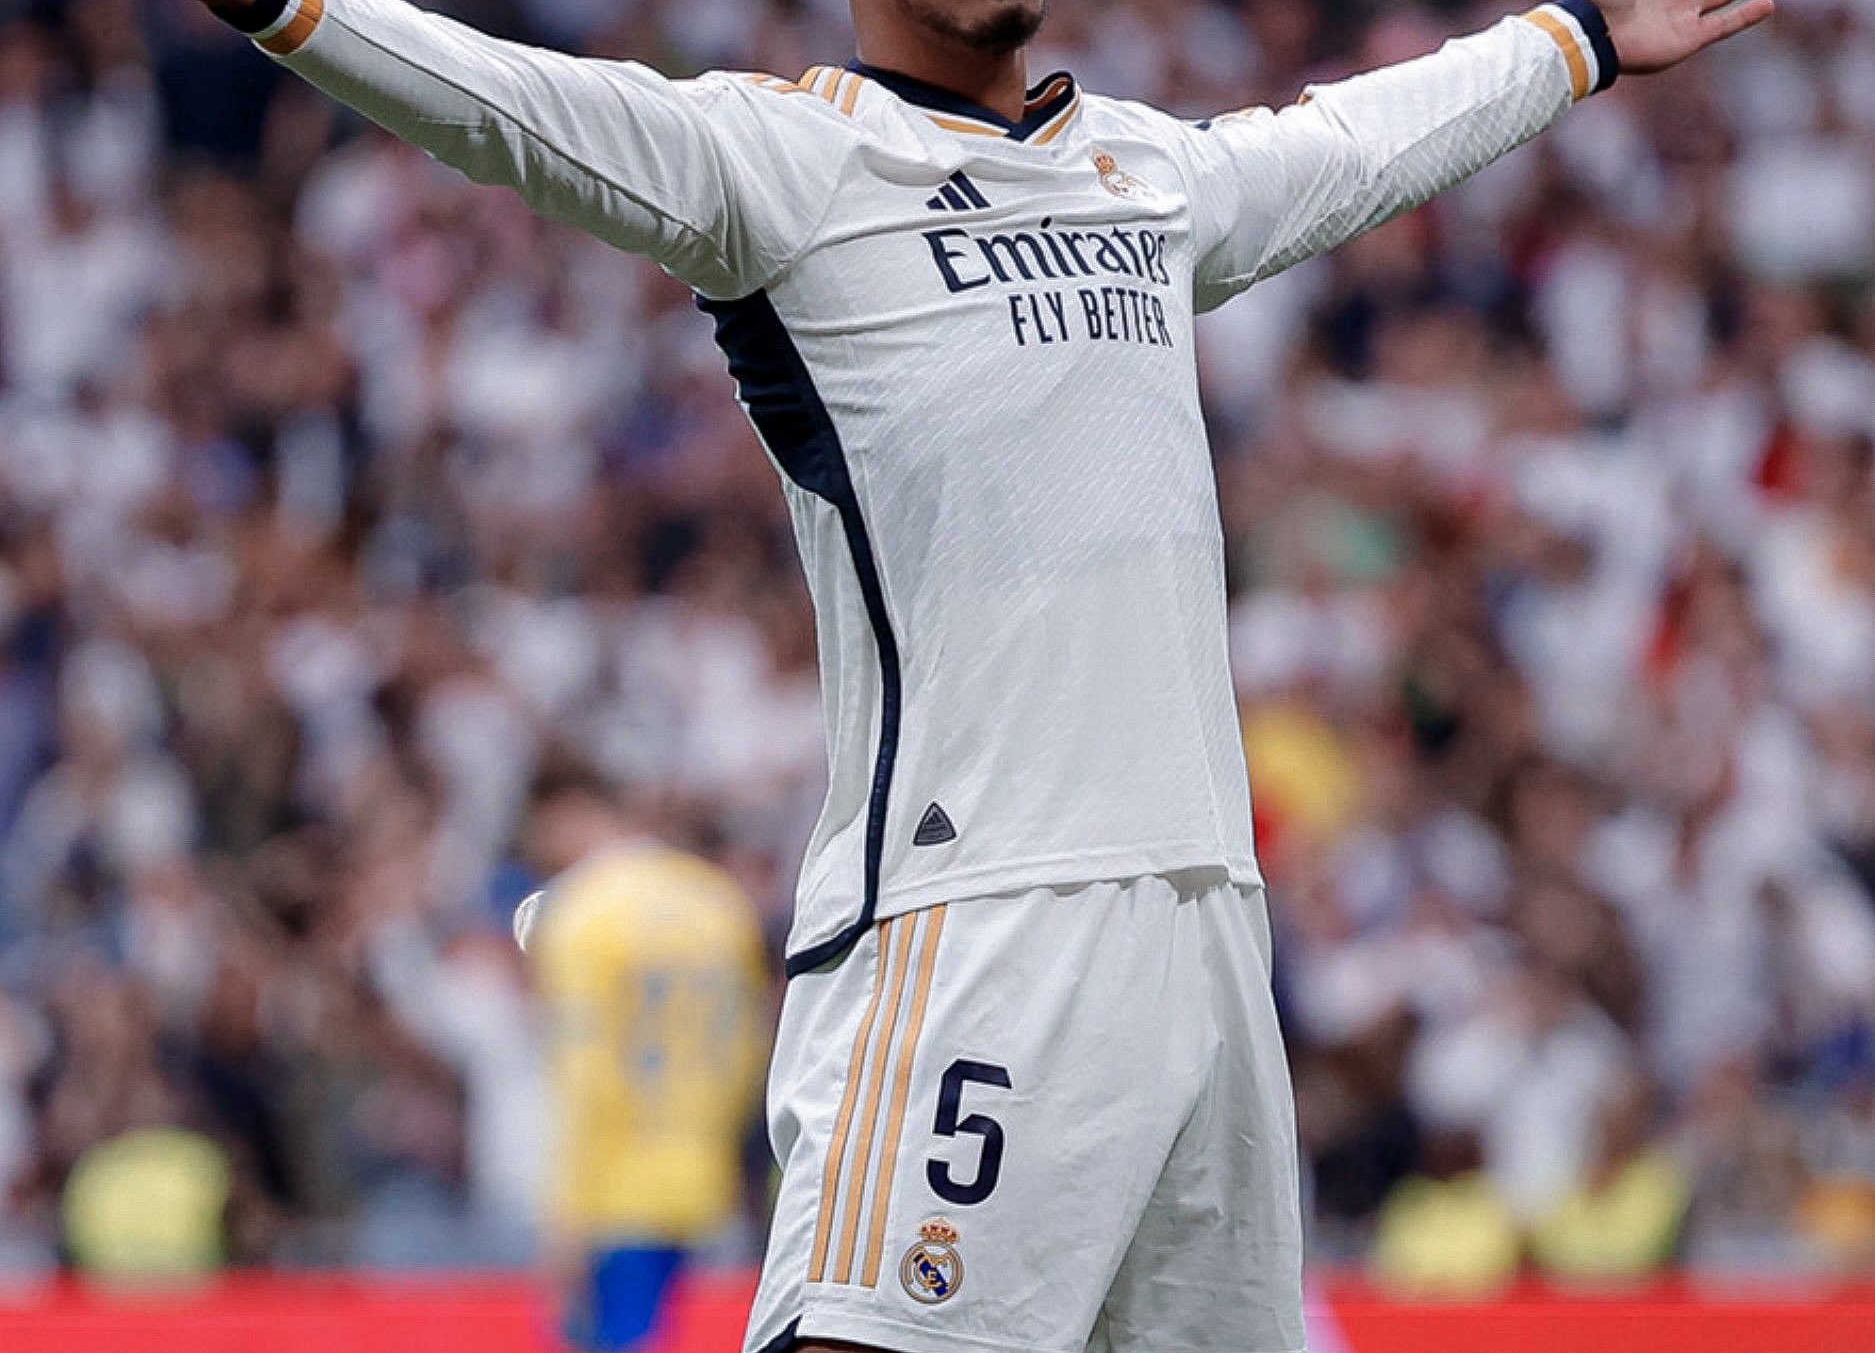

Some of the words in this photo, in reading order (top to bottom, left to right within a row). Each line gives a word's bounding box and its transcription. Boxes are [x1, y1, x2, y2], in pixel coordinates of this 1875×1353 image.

[922, 216, 1169, 293] Emirates
[1009, 292, 1068, 346] FLY
[1079, 287, 1173, 347] BETTER
[927, 1059, 1012, 1205] 5
